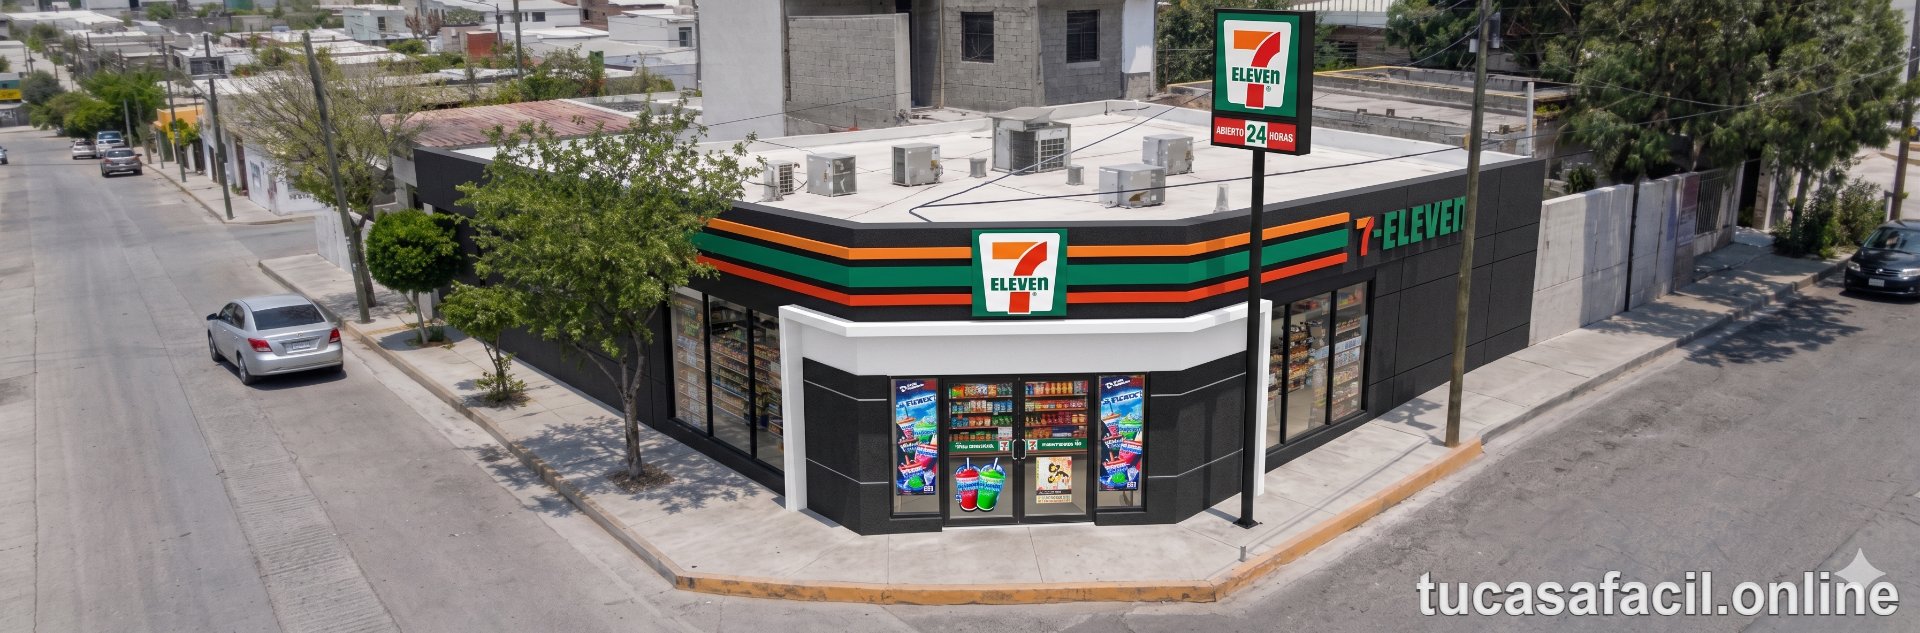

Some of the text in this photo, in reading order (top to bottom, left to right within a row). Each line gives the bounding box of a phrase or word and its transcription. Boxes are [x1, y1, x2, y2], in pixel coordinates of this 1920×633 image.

[1233, 30, 1281, 108] 7
[1216, 123, 1294, 144] ABIERTO 24 HORAS
[992, 241, 1047, 313] 7
